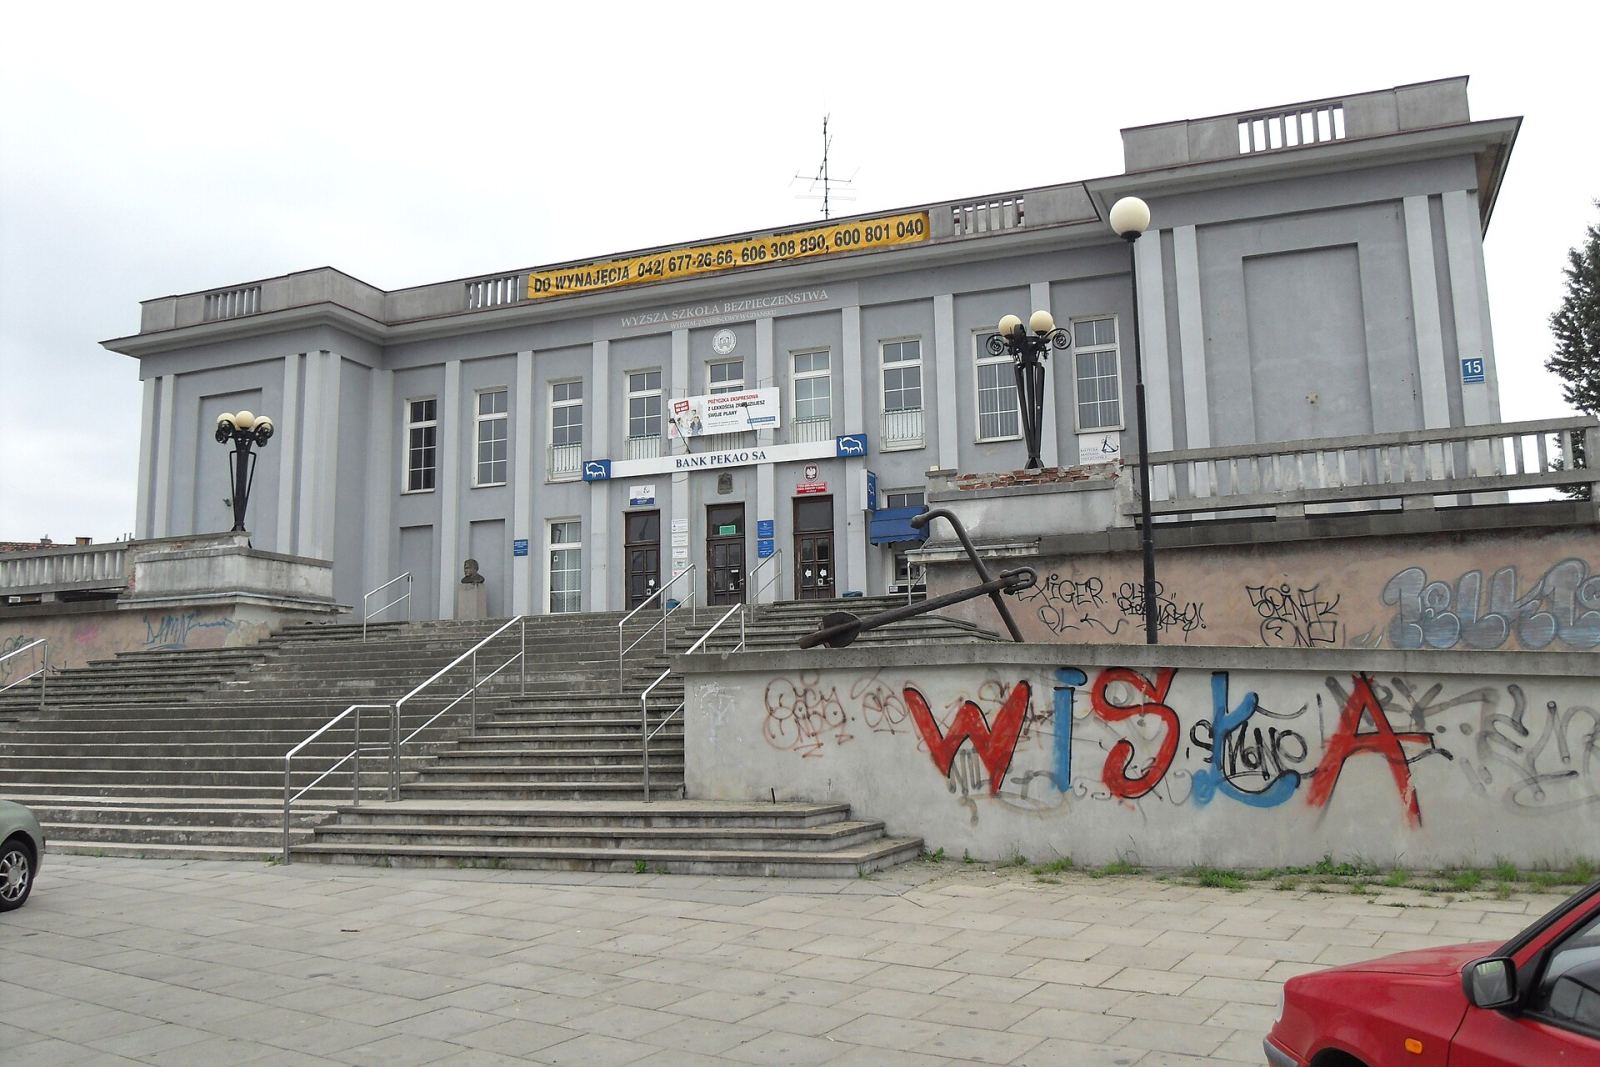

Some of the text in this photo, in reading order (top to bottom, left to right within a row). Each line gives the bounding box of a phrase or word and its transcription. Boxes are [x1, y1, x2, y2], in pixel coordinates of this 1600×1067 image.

[534, 218, 924, 293] DO WYNAJĘCIA 042/ 677-26-66, 606 308 890, 600 801 040
[724, 289, 828, 312] BEZPIECZEŃSTWA
[1464, 360, 1481, 374] 15
[676, 451, 766, 468] BANK PEKAO SA
